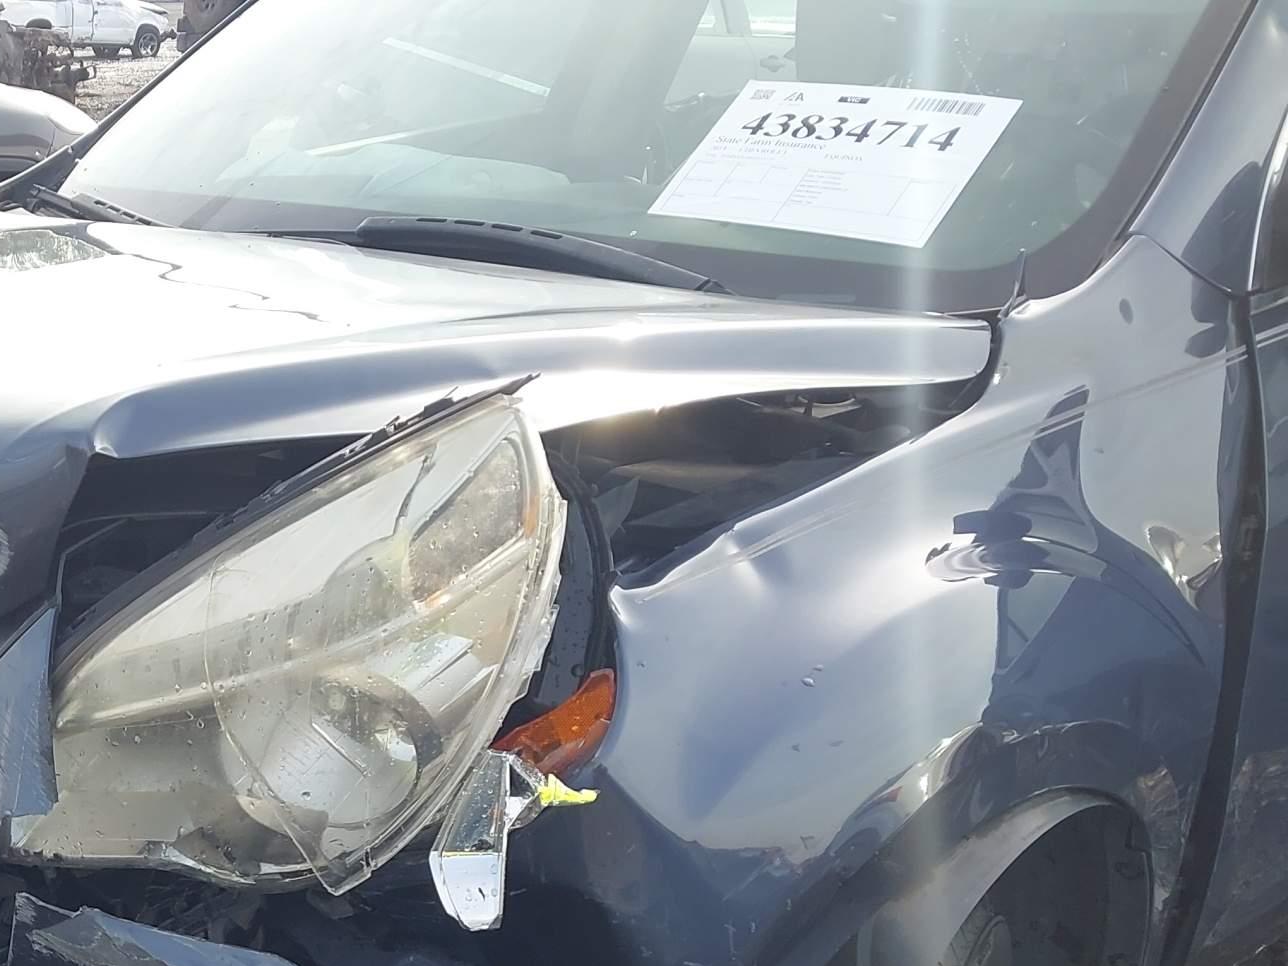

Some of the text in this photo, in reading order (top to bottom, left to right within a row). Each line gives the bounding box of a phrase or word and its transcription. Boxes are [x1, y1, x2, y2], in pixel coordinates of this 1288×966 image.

[715, 135, 827, 151] State Farm Insurance
[742, 111, 963, 152] 43834714
